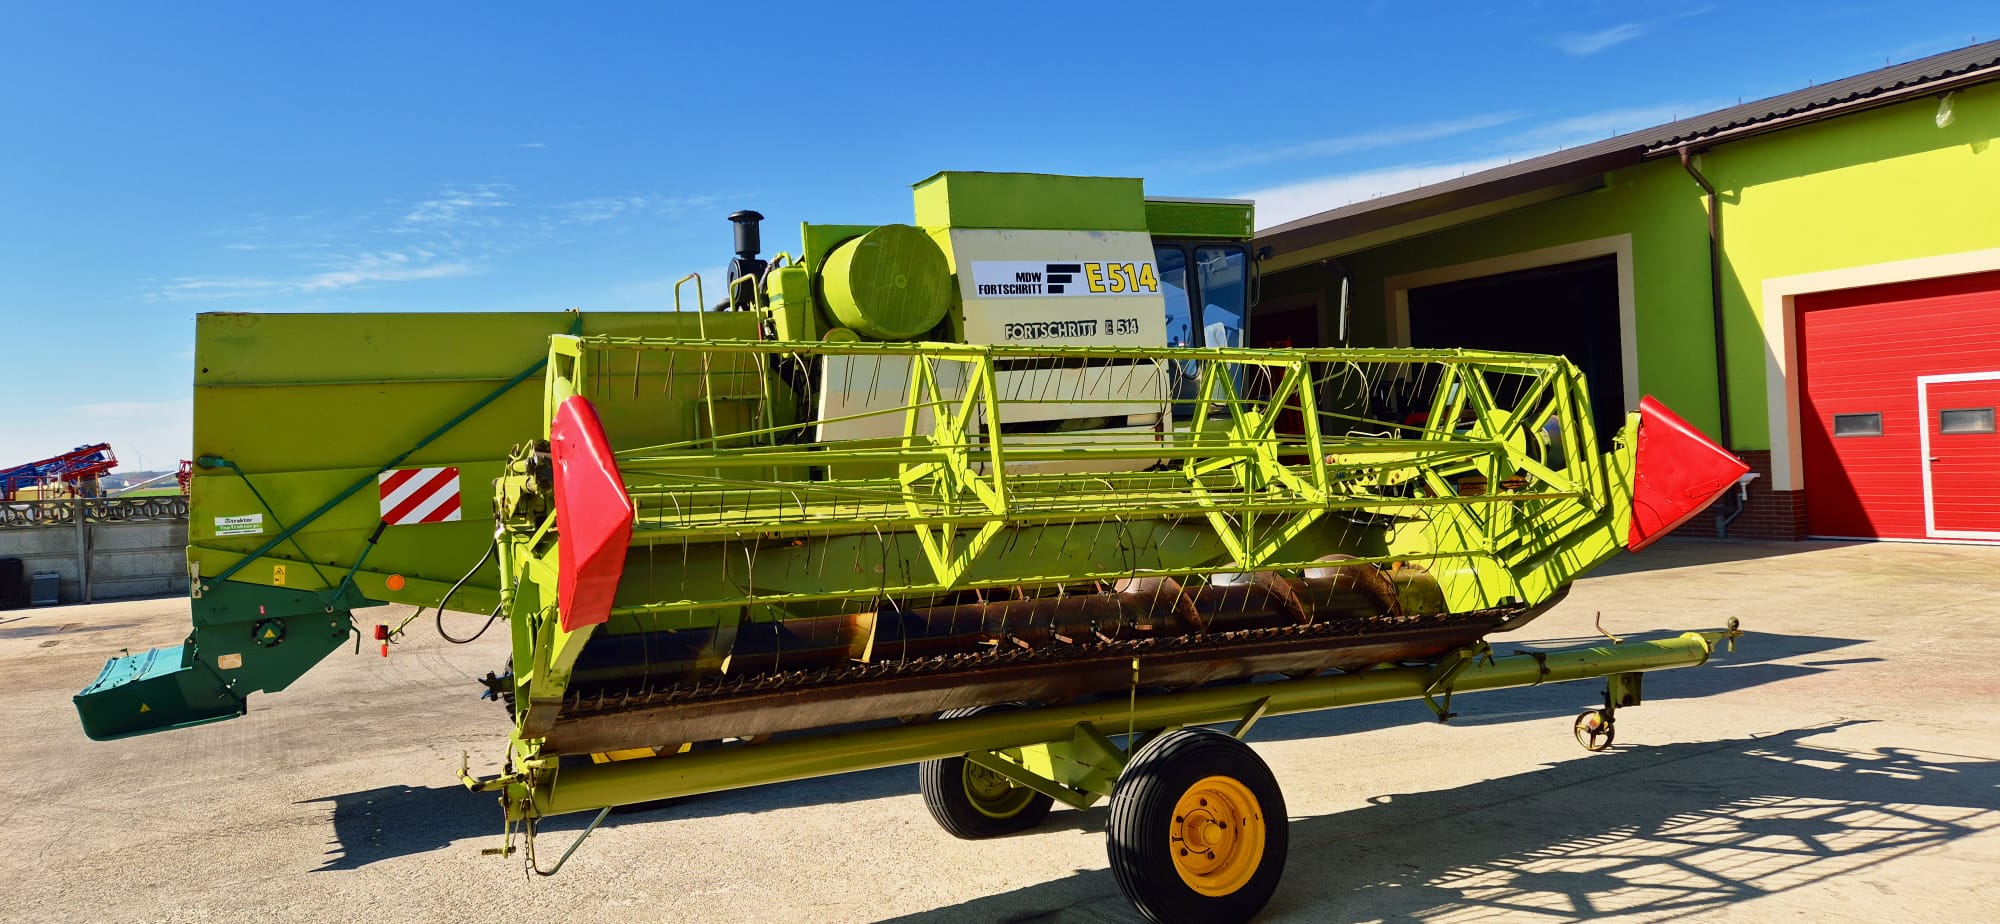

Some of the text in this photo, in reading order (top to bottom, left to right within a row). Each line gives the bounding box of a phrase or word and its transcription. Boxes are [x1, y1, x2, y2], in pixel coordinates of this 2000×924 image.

[1015, 272, 1042, 283] MDW
[978, 284, 1042, 295] FORTSCHRITT
[1005, 319, 1139, 340] FORTSCHRITT E 514
